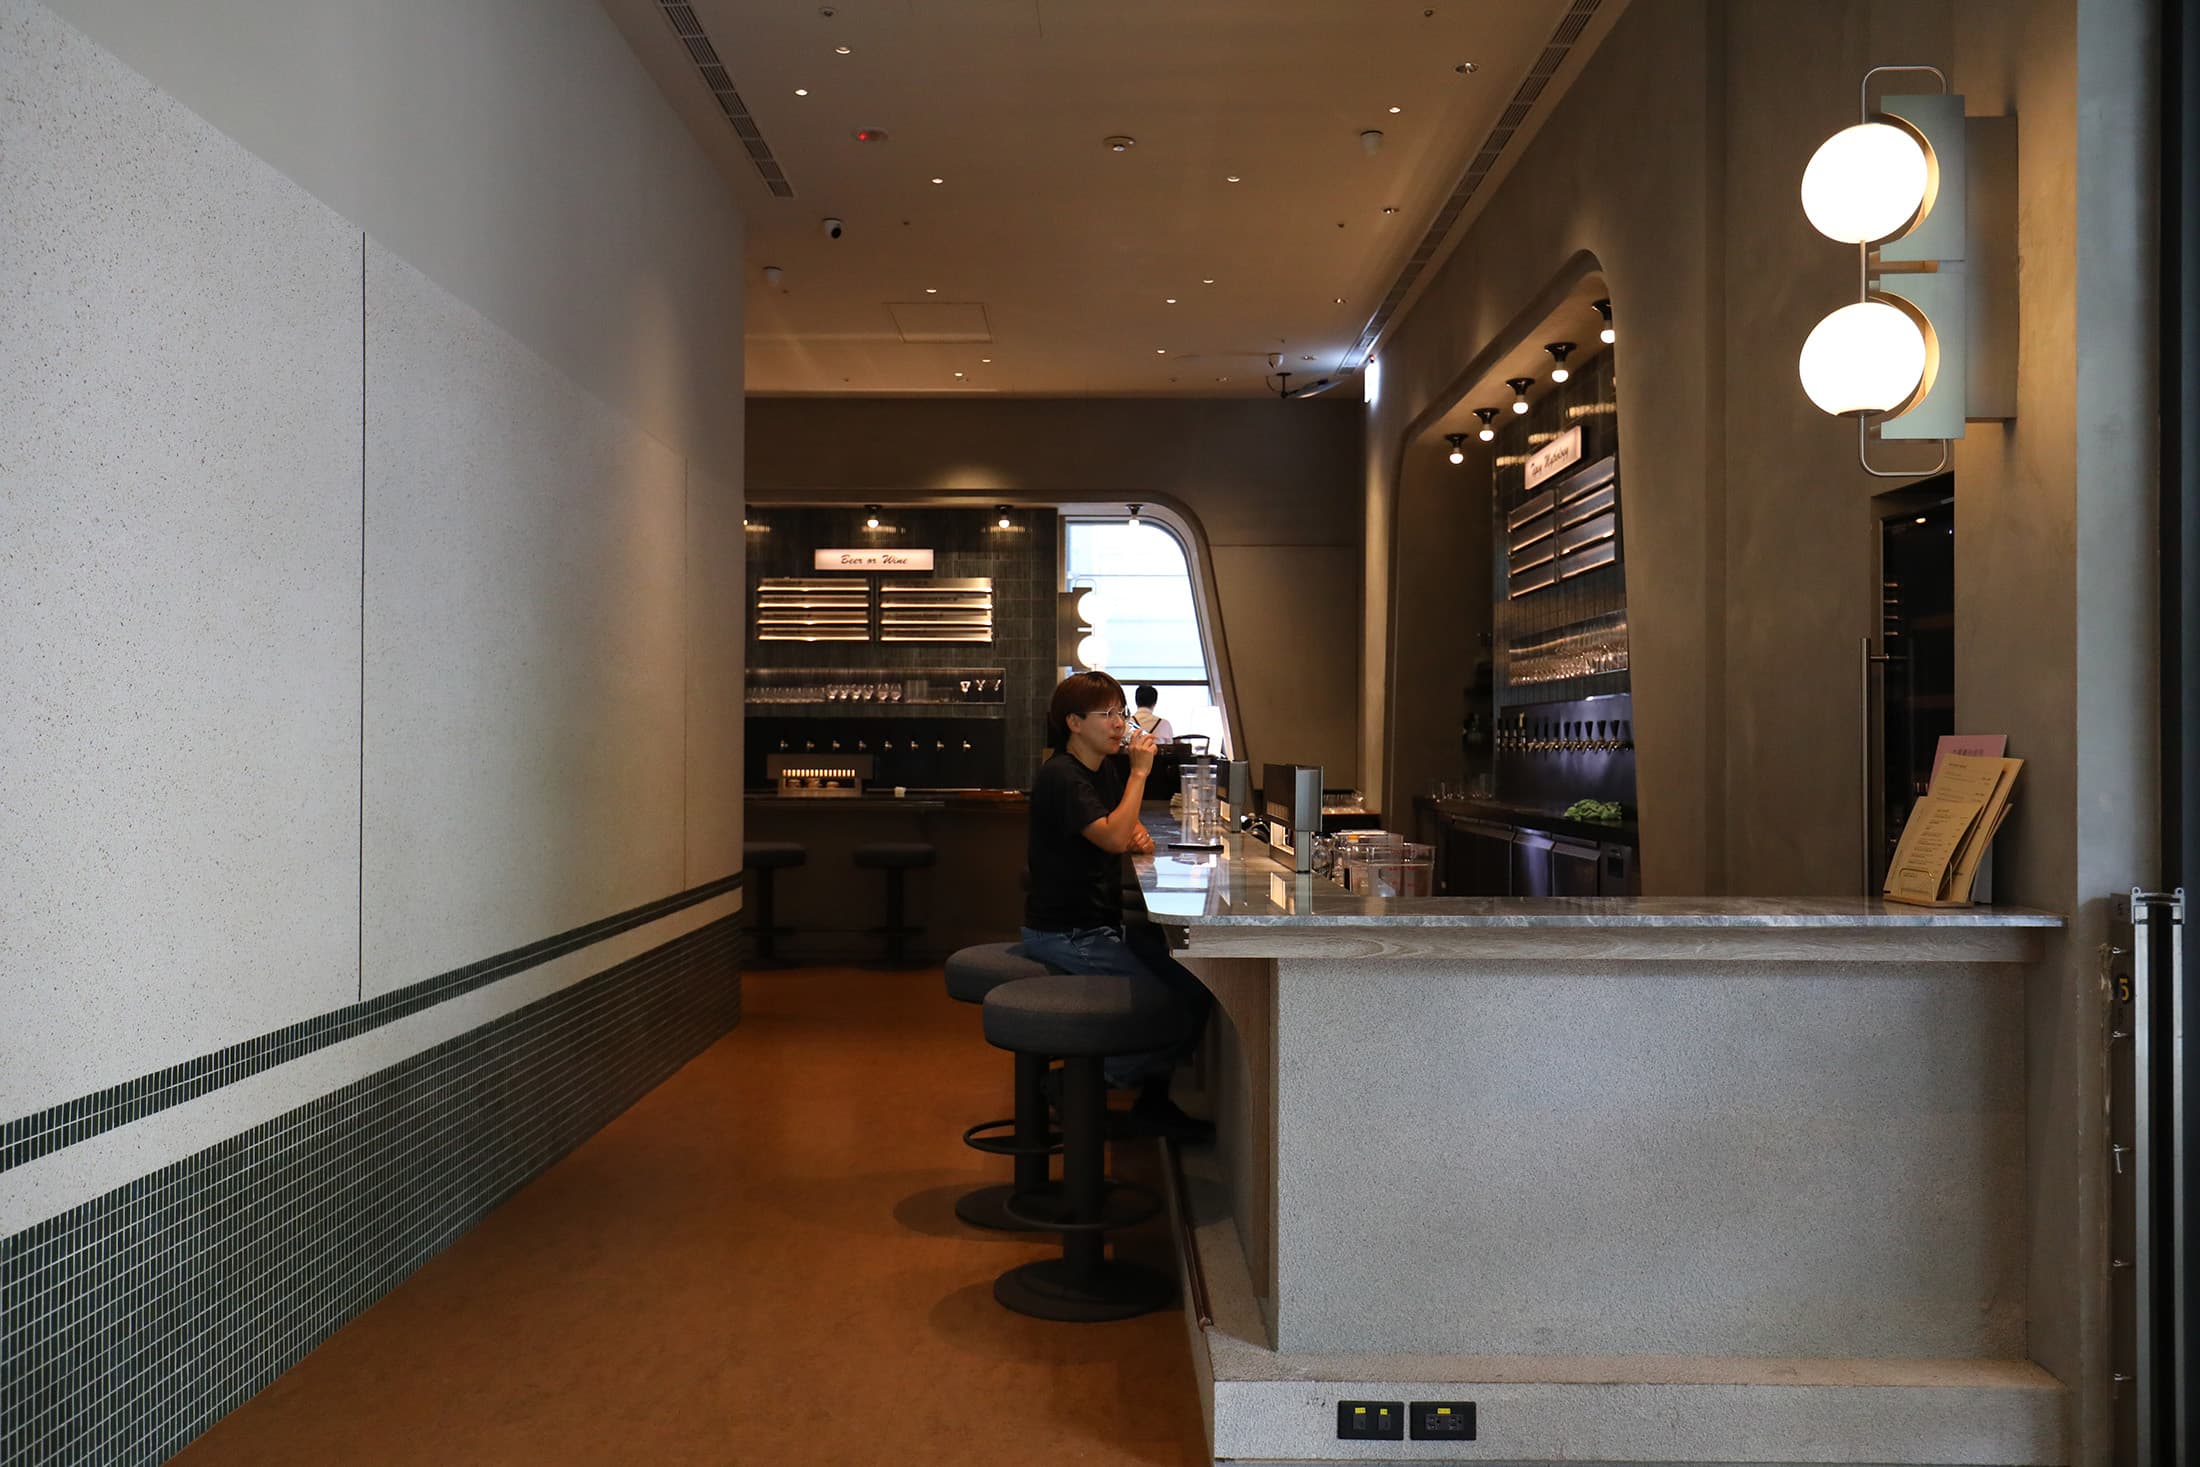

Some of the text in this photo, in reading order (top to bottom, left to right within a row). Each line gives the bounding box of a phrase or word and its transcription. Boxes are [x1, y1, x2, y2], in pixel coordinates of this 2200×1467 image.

[841, 554, 908, 565] Beer or Wine
[2119, 977, 2130, 1001] 5
